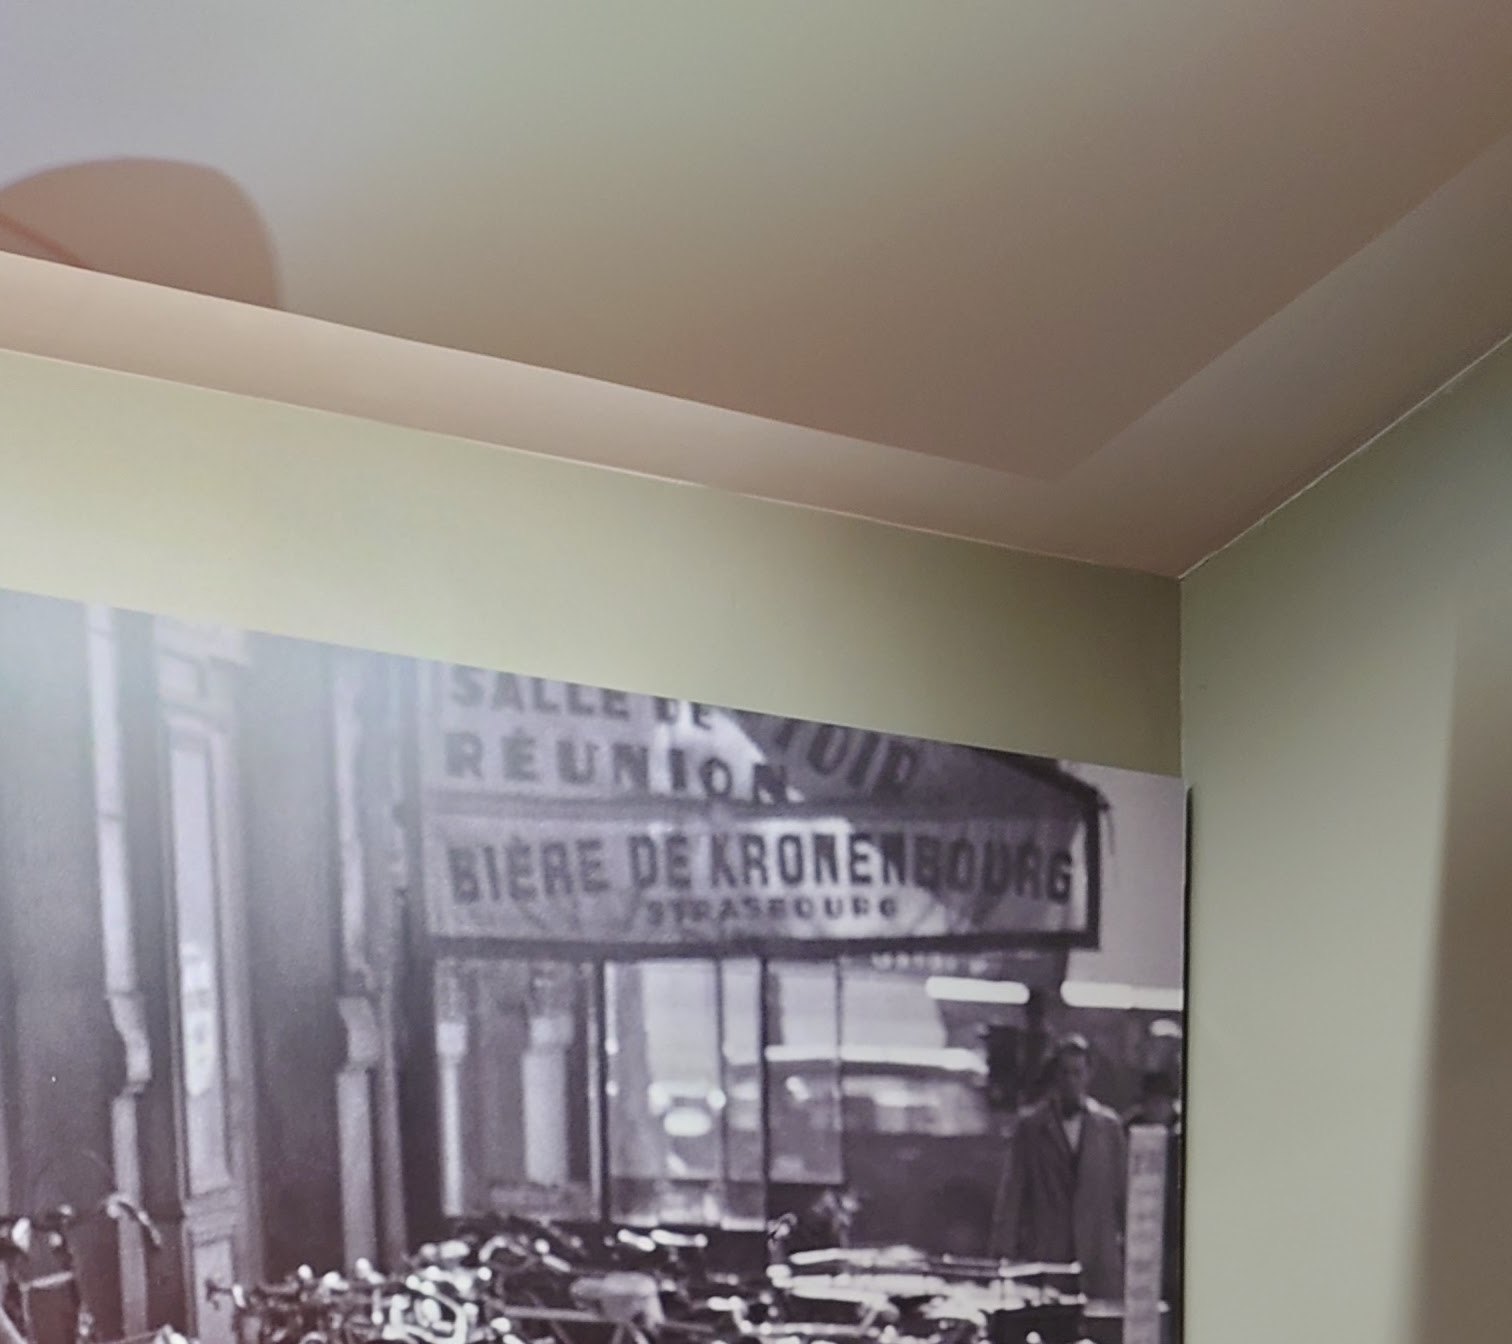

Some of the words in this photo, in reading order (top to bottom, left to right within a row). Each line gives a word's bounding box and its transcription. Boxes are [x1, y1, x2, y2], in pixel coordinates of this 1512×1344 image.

[450, 662, 631, 723] SALLE
[443, 726, 790, 805] RÉUNION
[447, 831, 610, 906] BIÈRE
[628, 832, 693, 889] DE
[708, 831, 1073, 905] KRONENBOURG
